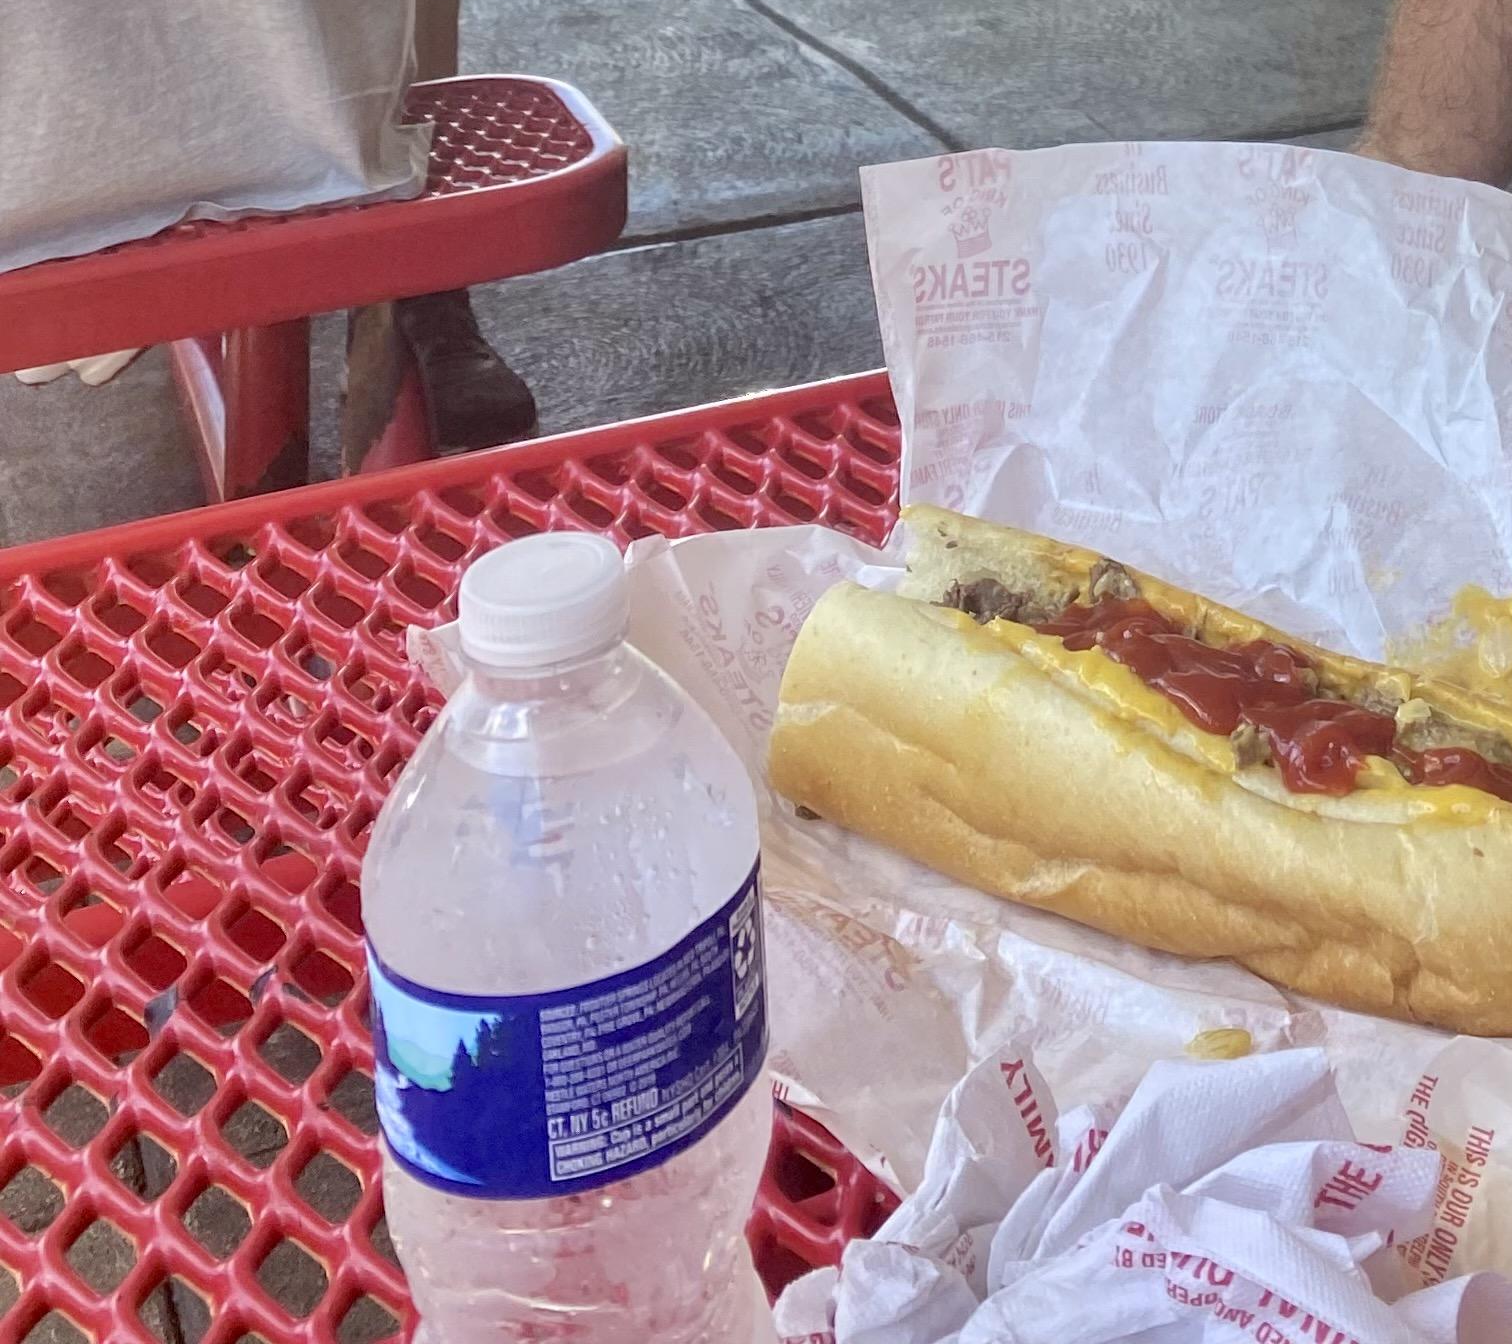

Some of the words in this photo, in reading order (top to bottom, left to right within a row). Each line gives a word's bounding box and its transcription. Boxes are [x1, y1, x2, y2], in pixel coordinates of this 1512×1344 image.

[611, 1087, 659, 1123] REFUND
[1410, 1074, 1439, 1110] THE
[1001, 1059, 1054, 1169] MILY
[1465, 1125, 1495, 1167] THIS
[1314, 1159, 1383, 1210] THE
[1457, 1167, 1481, 1188] IS
[1440, 1188, 1473, 1228] OUR
[1424, 1227, 1458, 1279] ONLY
